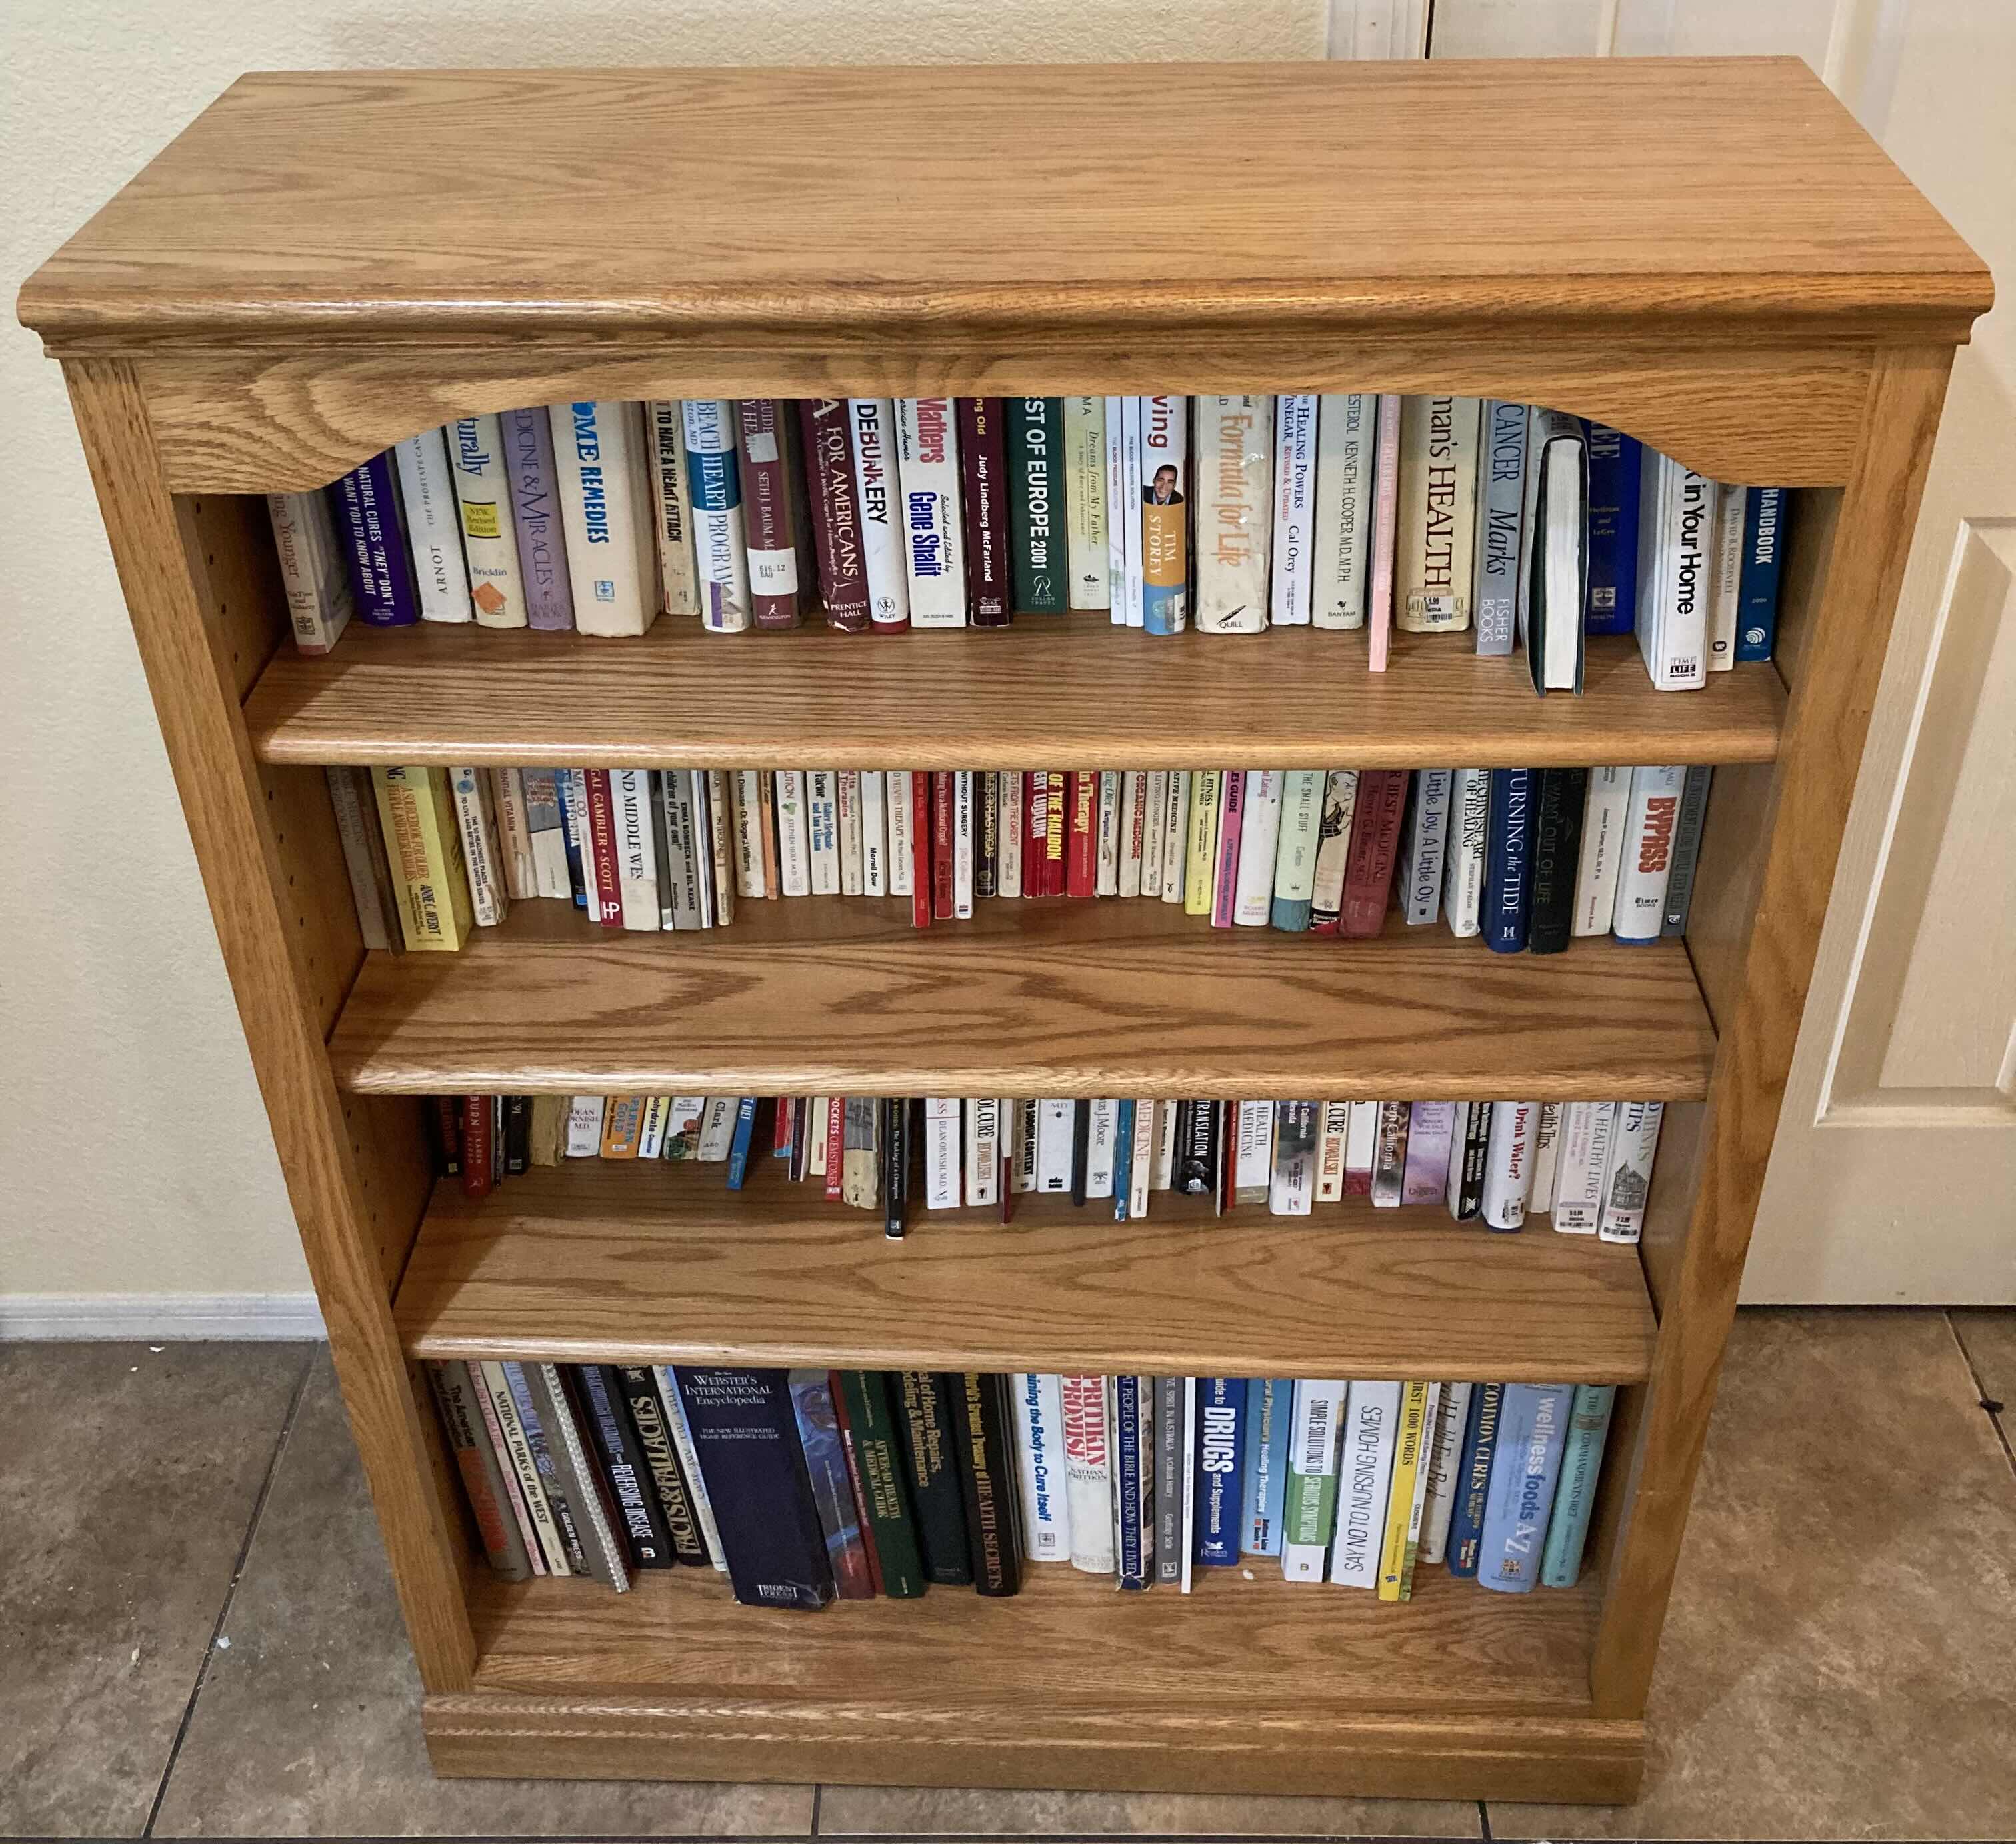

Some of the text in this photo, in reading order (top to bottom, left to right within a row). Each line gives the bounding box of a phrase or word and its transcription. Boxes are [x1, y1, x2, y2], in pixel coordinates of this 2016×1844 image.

[697, 402, 727, 509] BEACH HEART
[826, 427, 846, 462] FOR
[857, 404, 888, 525] DEBUNKERY
[1089, 432, 1100, 467] Dreams
[1294, 407, 1309, 508] HEALING POWERS
[1492, 403, 1525, 483] CANCER
[357, 467, 381, 541] NATURAL CURES
[657, 411, 682, 543] TO HAVE HEART ATTACK
[1027, 429, 1049, 568] OF EUROPE 2001
[1211, 415, 1253, 567] Formula Life
[1340, 441, 1359, 534] KENNETH COOPER
[580, 467, 609, 543] REMEDIES
[831, 469, 858, 577] AMERICANS
[977, 455, 992, 581] Judy Lindberg McFarland
[1424, 465, 1456, 587] HEALTH
[1755, 489, 1779, 564] HANDBOOK
[280, 523, 301, 578] Younger
[343, 478, 376, 595] WANT YOU TO KNOW ABOUT
[518, 489, 553, 585] MIRACLES
[909, 492, 941, 577] Gene Shalit
[1149, 515, 1161, 576] STOREY
[1163, 530, 1176, 560] TIM
[1285, 548, 1299, 573] Orey
[1289, 525, 1299, 543] Cal
[1487, 509, 1517, 575] Marks
[1677, 485, 1705, 615] in Your Home
[431, 546, 448, 594] ARNOT
[831, 601, 867, 611] PRENTICE
[1481, 599, 1494, 642] BOOKS
[1495, 599, 1509, 640] FISHER
[1670, 657, 1697, 665] TIME
[681, 802, 689, 822] ERMA
[815, 774, 827, 797] Factor
[1074, 784, 1093, 833] Therapy
[1205, 778, 1213, 806] FITNESS
[1229, 786, 1239, 813] GUIDE
[1297, 789, 1311, 832] SMALL STUFF
[623, 795, 641, 849] MIDDLE
[668, 811, 680, 826] your
[895, 807, 904, 837] THERAPY
[1033, 793, 1046, 838] LUDLUM
[1046, 774, 1063, 859] OF THE HALIDON
[1131, 818, 1142, 859] MEDICINE
[1171, 797, 1179, 833] MEDICINE
[1415, 772, 1446, 902] Little Joy, A Little Oy
[1463, 780, 1478, 847] OF HEALING
[1639, 797, 1677, 873] BYPASS
[593, 793, 613, 892] GAMBLER SCOTT
[683, 825, 691, 859] BOMBECK
[1508, 856, 1522, 871] the
[473, 867, 481, 886] UNITED
[1502, 874, 1521, 914] TIDE
[711, 1101, 725, 1129] Clark
[741, 1105, 752, 1120] DIET
[939, 1121, 947, 1140] DEAN
[977, 1113, 995, 1138] CURE
[1096, 1119, 1109, 1146] Moore
[1135, 1100, 1151, 1161] MEDICINE
[1194, 1100, 1210, 1156] TRANSLATION
[1240, 1108, 1254, 1159] MEDICINE
[1300, 1109, 1309, 1139] California
[1536, 1129, 1555, 1149] Tips
[827, 1136, 839, 1185] GEMSTONES
[1323, 1109, 1345, 1175] CURE KOWALSKI
[1383, 1124, 1398, 1170] California
[1509, 1109, 1529, 1179] Drink Water?
[1585, 1119, 1609, 1199] HEALTHY LIVES
[685, 1385, 773, 1395] INTERNATIONAL
[693, 1375, 757, 1385] WEBSTER'S
[696, 1395, 766, 1406] Encyclopedia
[923, 1397, 936, 1427] Home
[1307, 1400, 1328, 1460] SIMPLE SOLUTIONS
[1403, 1408, 1420, 1466] 1000 WORDS
[1471, 1383, 1499, 1489] COMMON CURES
[494, 1391, 548, 1523] NATIONAL PARKS WEST
[910, 1420, 929, 1487] Maintenance
[1030, 1409, 1051, 1521] the Body to Cure Itself
[1123, 1388, 1135, 1547] PEOPLE OF THE BIBLE AND HOW THEY
[1202, 1407, 1236, 1473] DRUGS
[1259, 1444, 1269, 1473] Healing
[611, 1465, 653, 1538] REVERSING DISEASE
[1211, 1473, 1222, 1533] and Supplements
[1345, 1407, 1383, 1571] SAY NO NURSING HOMES
[561, 1512, 583, 1559] GOLDEN PRESS
[977, 1481, 1002, 1589] HEALTH SECRETS
